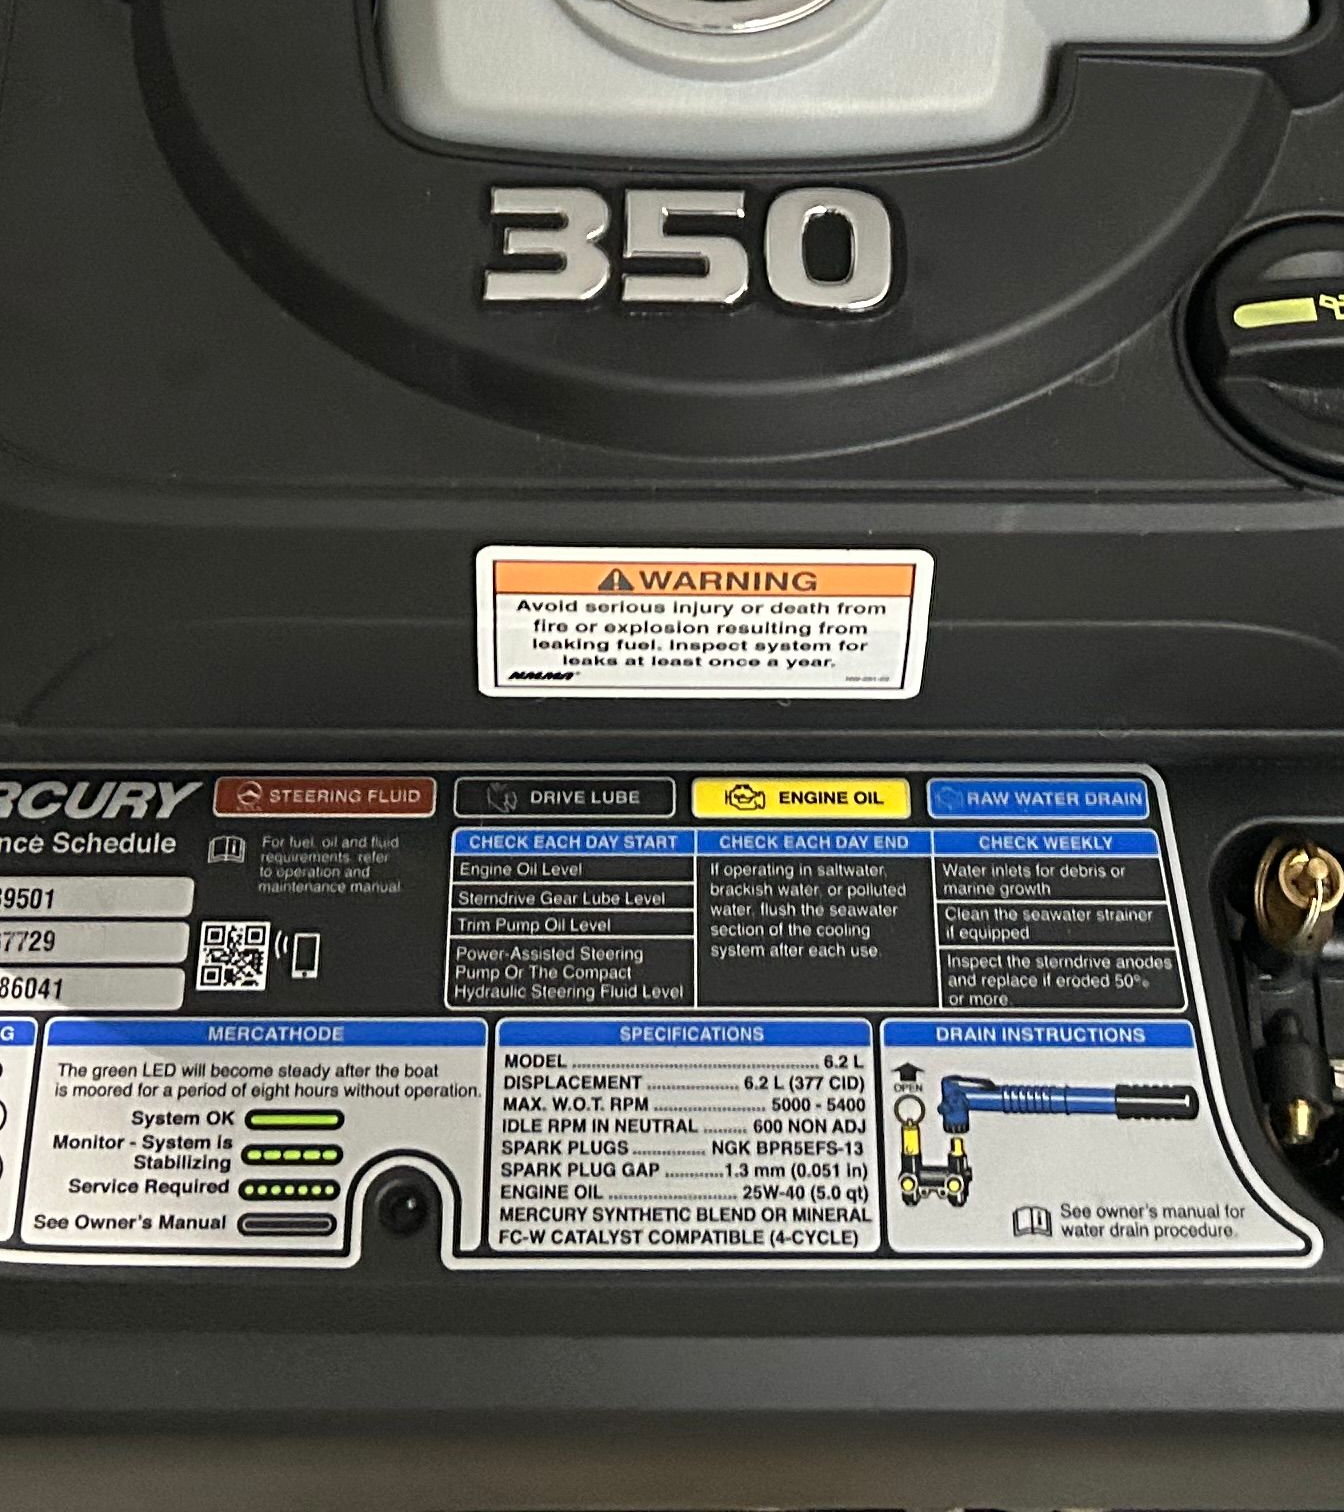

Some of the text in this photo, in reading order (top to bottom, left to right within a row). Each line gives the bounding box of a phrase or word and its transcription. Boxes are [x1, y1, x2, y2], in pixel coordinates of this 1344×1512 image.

[482, 186, 894, 312] 350
[637, 570, 816, 594] WARNING
[517, 599, 885, 617] Avoid serious injury or death from
[534, 619, 867, 636] fire or explosion resulting from
[533, 638, 867, 653] leaking fuel. Inspect system for
[563, 655, 834, 669] leaks at least once a year.
[270, 789, 420, 803] STEERING FLUID
[530, 790, 639, 804] DRIVE LUBE
[779, 791, 883, 804] ENGINE OIL
[967, 791, 1142, 806] RAW WATER DRAIN
[52, 831, 175, 853] Schedule
[469, 835, 677, 849] CHECK EACH DAY START
[719, 835, 908, 849] CHECK EACH DAY END
[979, 835, 1112, 849] CHECK WEEKLY
[460, 862, 581, 879] Engine Oil Level
[458, 892, 665, 906] Sterndrive Gear Lube Level
[458, 919, 611, 935] Trim Pump Oil Level
[208, 1026, 343, 1041] MERCATHODE
[620, 1026, 763, 1041] SPECIFICATIONS
[936, 1027, 1145, 1042] DRAIN INSTRUCTIONS
[505, 1054, 567, 1068] MODEL
[824, 1054, 863, 1068] 6.2 L
[58, 1062, 438, 1080] The green LED will become steady after the boat
[504, 1075, 642, 1089] DISPLACEMENT
[744, 1075, 864, 1093] 6.2 L (377 CID)
[893, 1083, 922, 1092] OPEN
[55, 1082, 480, 1100] is moored for a period of eight hours without operation.
[503, 1096, 648, 1111] MAX. W.O.T. RPM
[772, 1097, 810, 1111] 5000
[827, 1097, 865, 1112] 5400
[131, 1109, 234, 1129] System OK
[502, 1118, 697, 1133] IDLE RPM IN NEUTRAL
[753, 1118, 865, 1133] 600 NON ADJ
[53, 1134, 124, 1149] Monitor
[142, 1134, 210, 1152] System
[217, 1134, 232, 1149] is
[502, 1140, 628, 1155] SPARK PLUGS
[712, 1140, 863, 1155] NGK BPR5EFS-13
[134, 1154, 230, 1173] Stabilizing
[501, 1162, 659, 1177] SPARK PLUG GAP
[725, 1162, 867, 1181] 1.3 mm (0.051 in)
[68, 1178, 229, 1197] Service Required
[501, 1184, 603, 1199] ENGINE OIL
[743, 1184, 868, 1203] 25W-40 (5.0 qt)
[500, 1207, 872, 1222] MERCURY SYNTHETIC BLEND OR MINERAL
[1060, 1204, 1245, 1219] See owner's manual for
[34, 1214, 226, 1229] See Owner's Manual
[1061, 1221, 1236, 1240] water drain procedure.
[499, 1229, 858, 1248] FC-W CATALYST COMPATIBLE (4-CYCLE)
